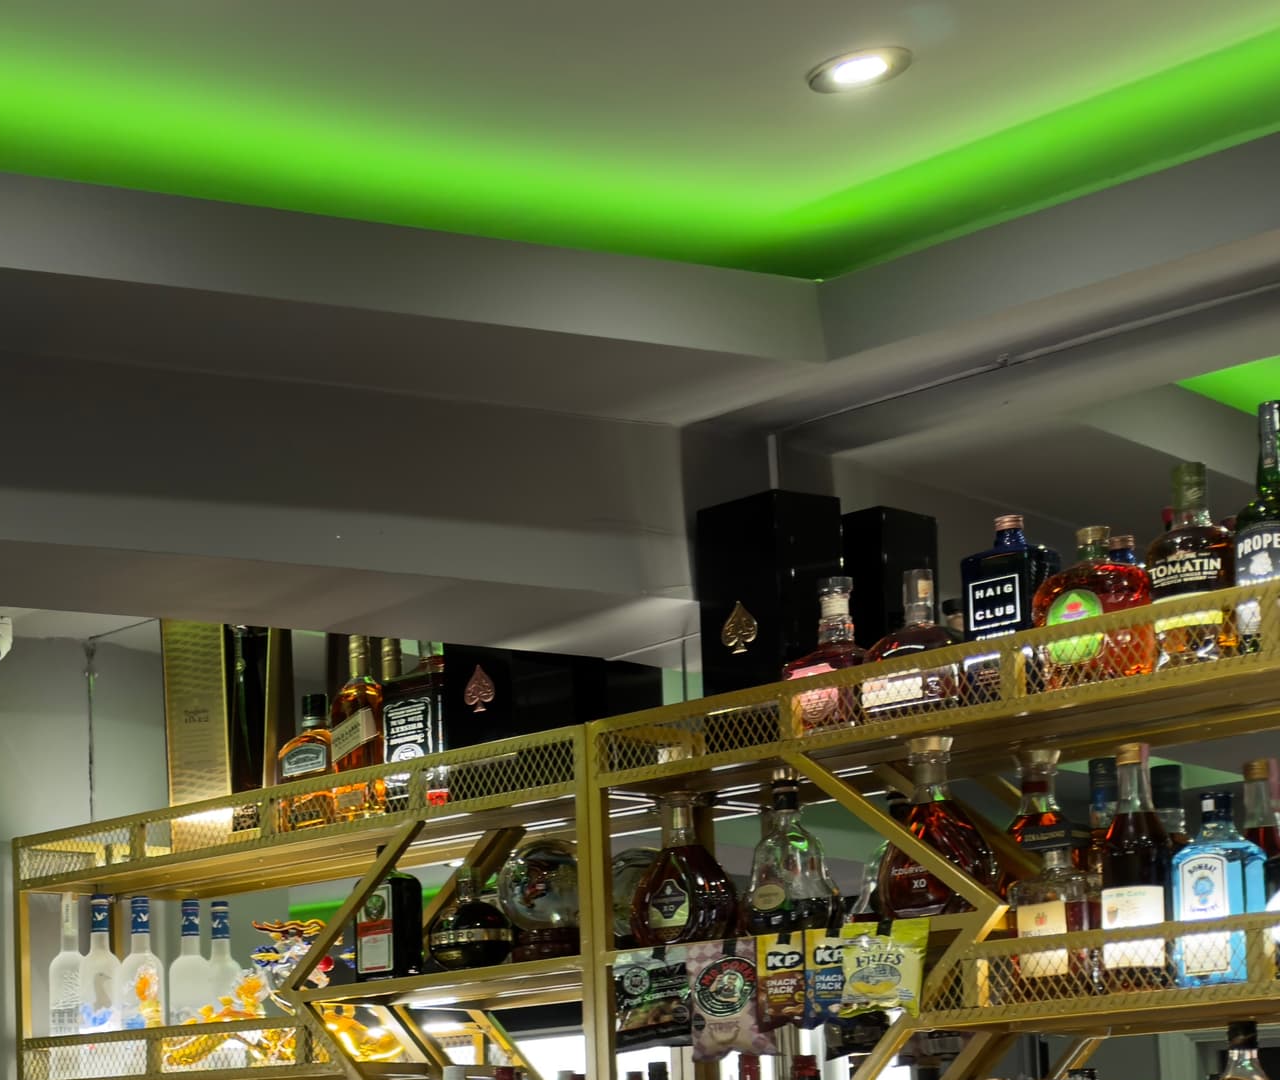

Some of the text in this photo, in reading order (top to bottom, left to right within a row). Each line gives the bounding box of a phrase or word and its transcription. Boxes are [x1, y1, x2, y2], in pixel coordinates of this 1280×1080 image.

[1148, 557, 1222, 580] TOMATIN
[975, 583, 1014, 600] HAIG
[974, 604, 1015, 621] CLUB
[912, 877, 927, 889] XO
[767, 952, 801, 969] KP
[855, 952, 906, 968] FRIES
[766, 977, 798, 987] SNACK
[767, 984, 795, 995] PACK
[815, 981, 842, 991] PACK
